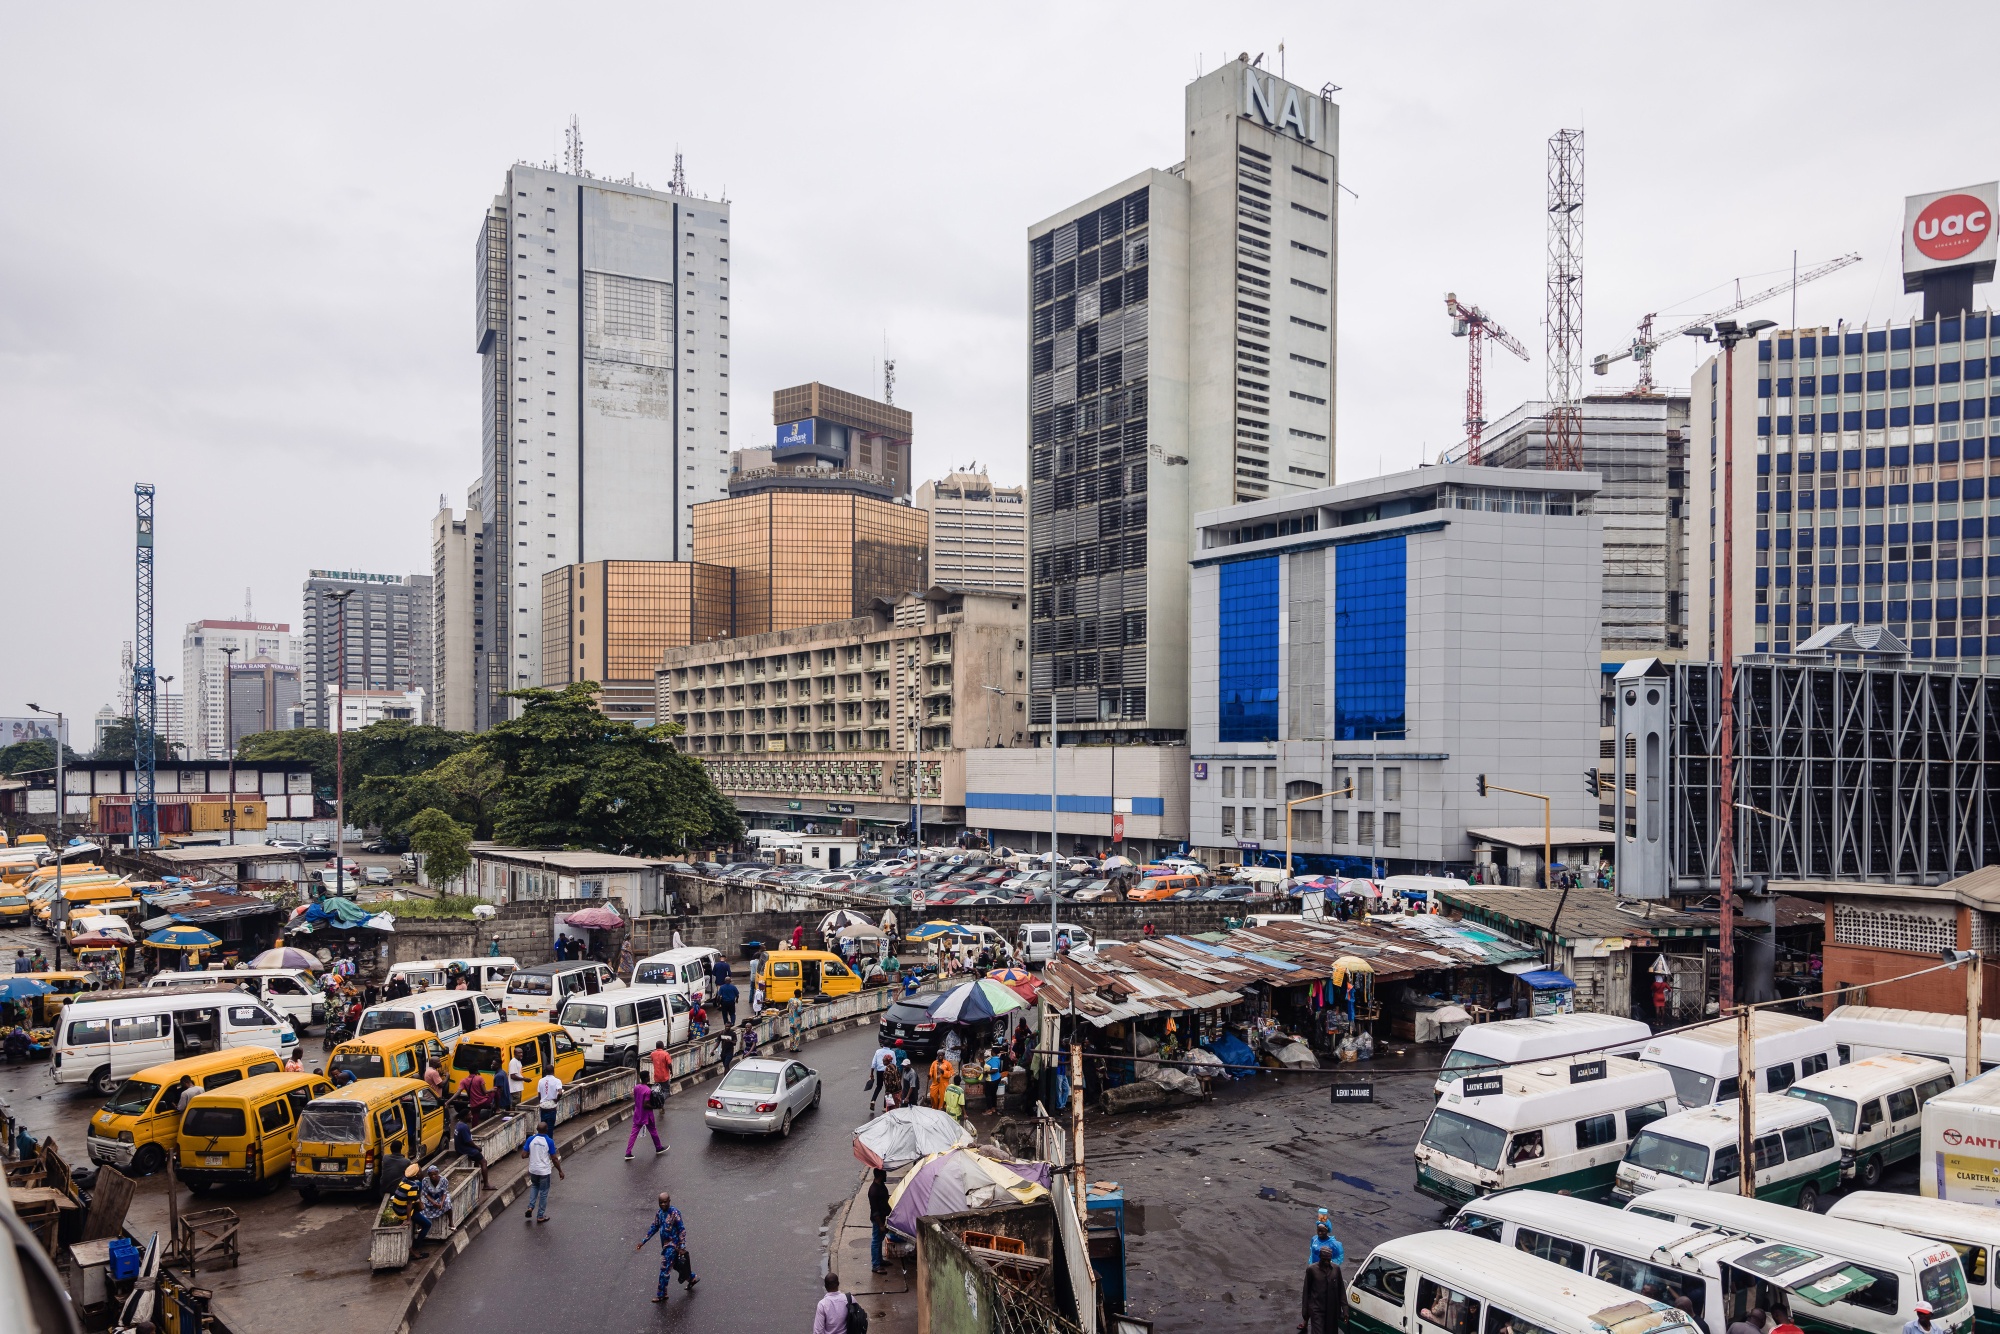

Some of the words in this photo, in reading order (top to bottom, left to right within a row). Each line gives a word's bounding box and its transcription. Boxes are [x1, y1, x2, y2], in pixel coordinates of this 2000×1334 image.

[1243, 66, 1317, 144] NAI
[1918, 211, 1986, 240] uac
[1336, 1089, 1349, 1097] LEKKI
[1956, 1171, 1991, 1183] CLARTEM
